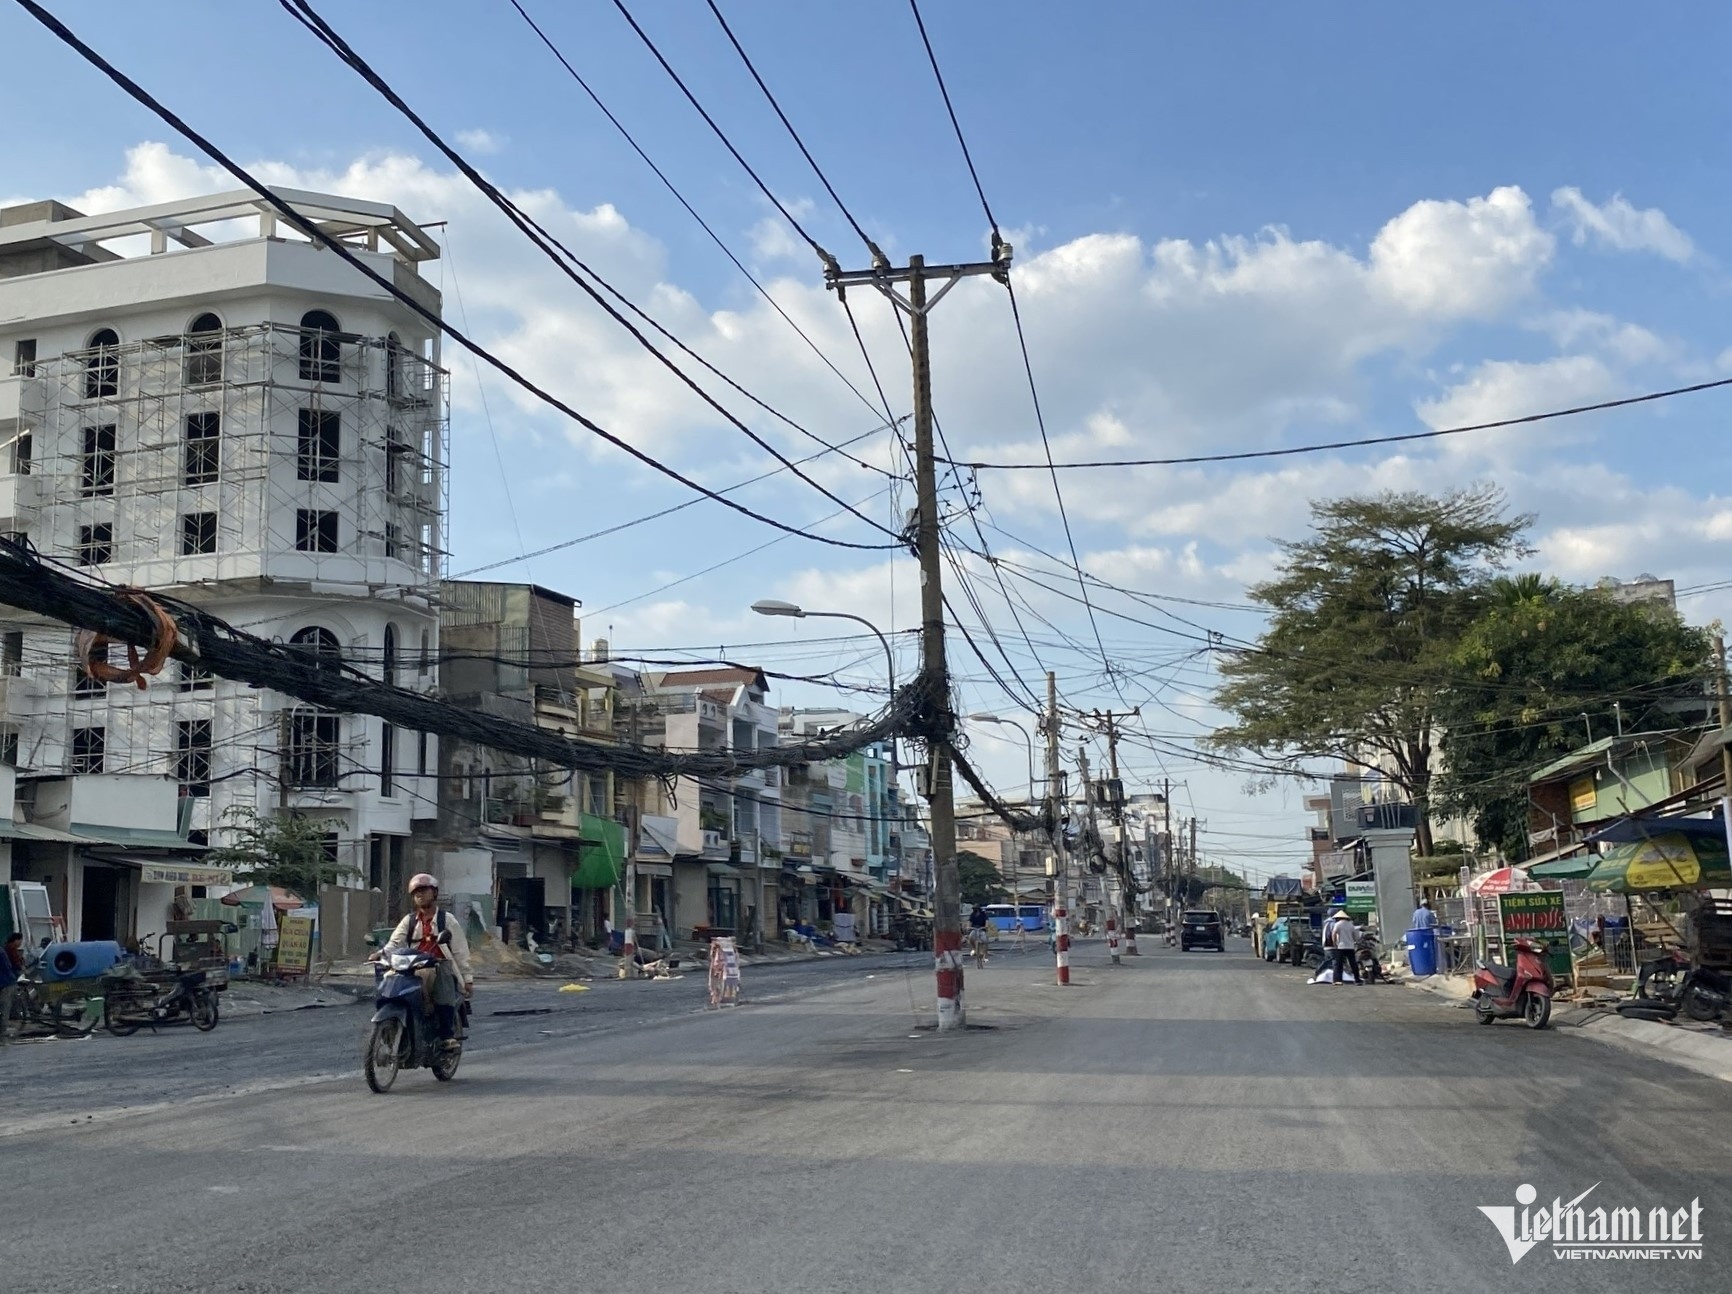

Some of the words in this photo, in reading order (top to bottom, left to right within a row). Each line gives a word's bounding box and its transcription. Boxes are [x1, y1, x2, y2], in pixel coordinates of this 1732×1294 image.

[1503, 897, 1526, 909] TIỆM
[1550, 896, 1562, 905] XE
[1504, 913, 1536, 929] ANH
